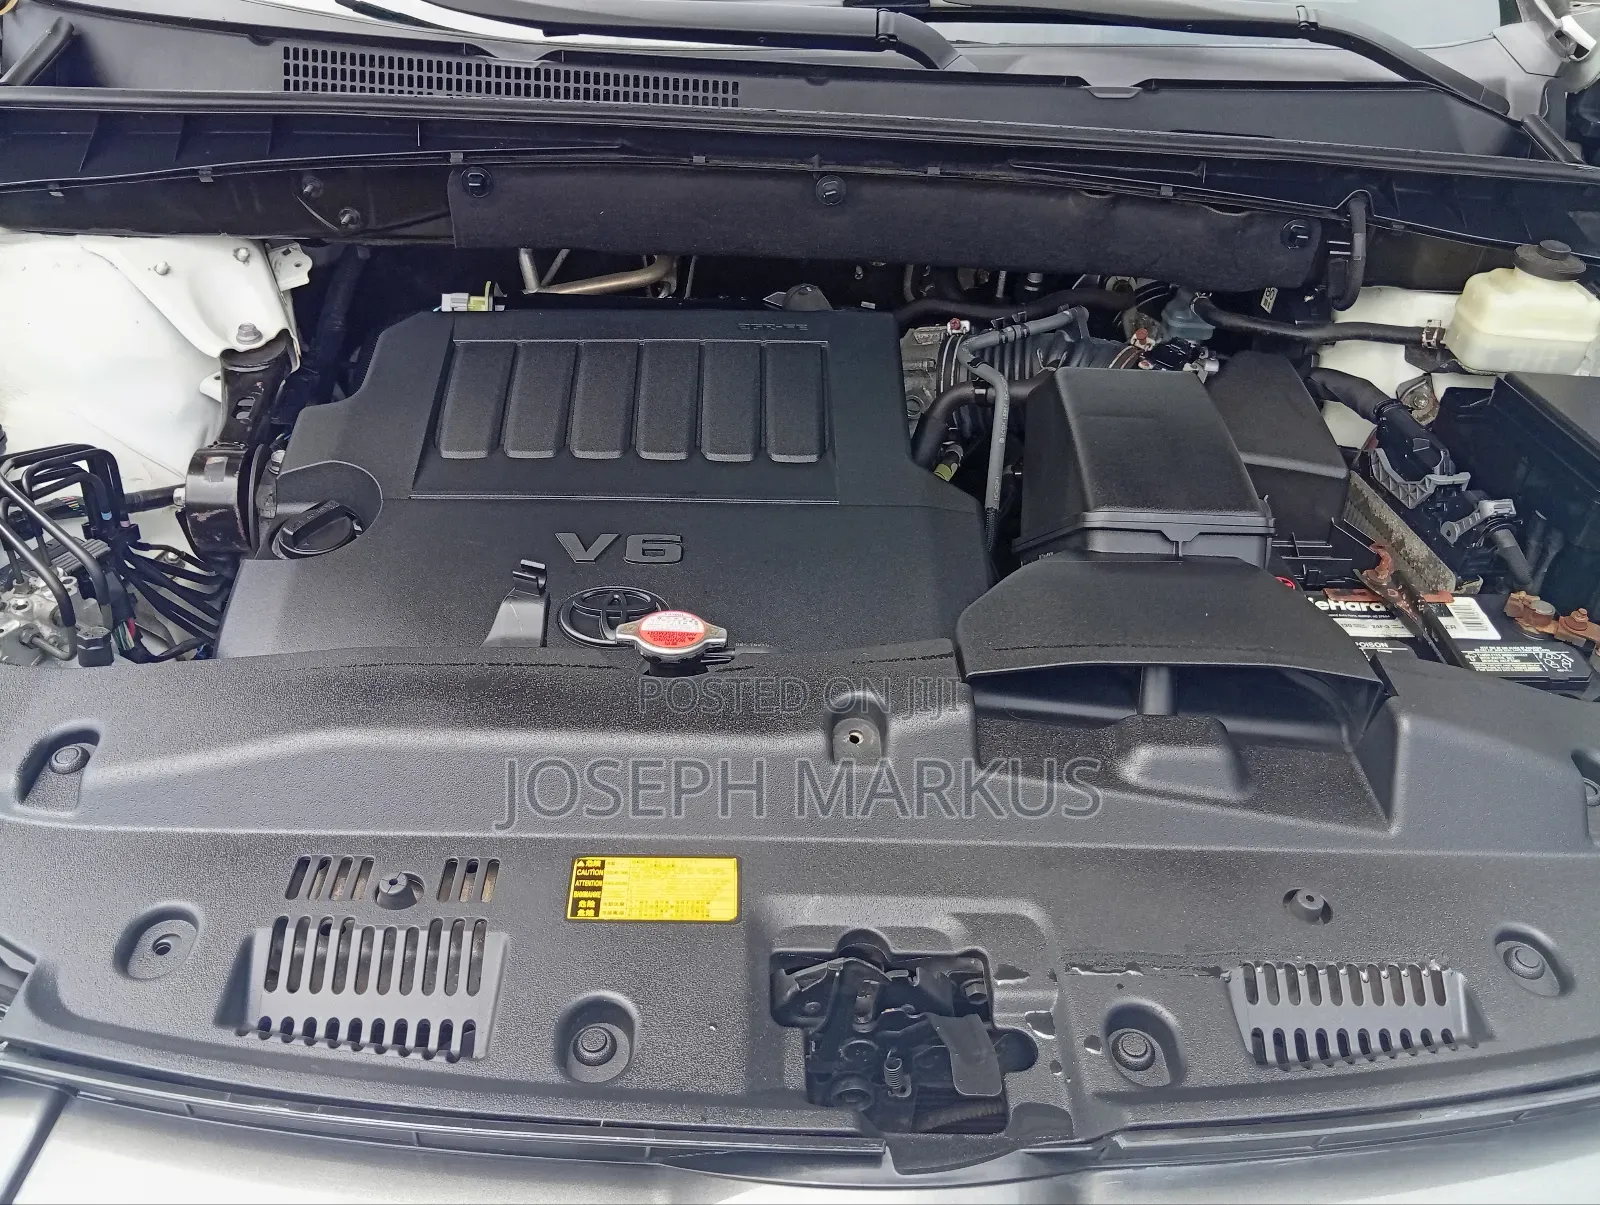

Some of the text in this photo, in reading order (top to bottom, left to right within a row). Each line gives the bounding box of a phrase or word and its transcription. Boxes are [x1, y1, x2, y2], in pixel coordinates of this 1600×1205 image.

[555, 532, 683, 564] V6
[1307, 597, 1386, 612] eHard
[576, 868, 604, 876] CAUTION
[574, 879, 603, 887] ATTENTION
